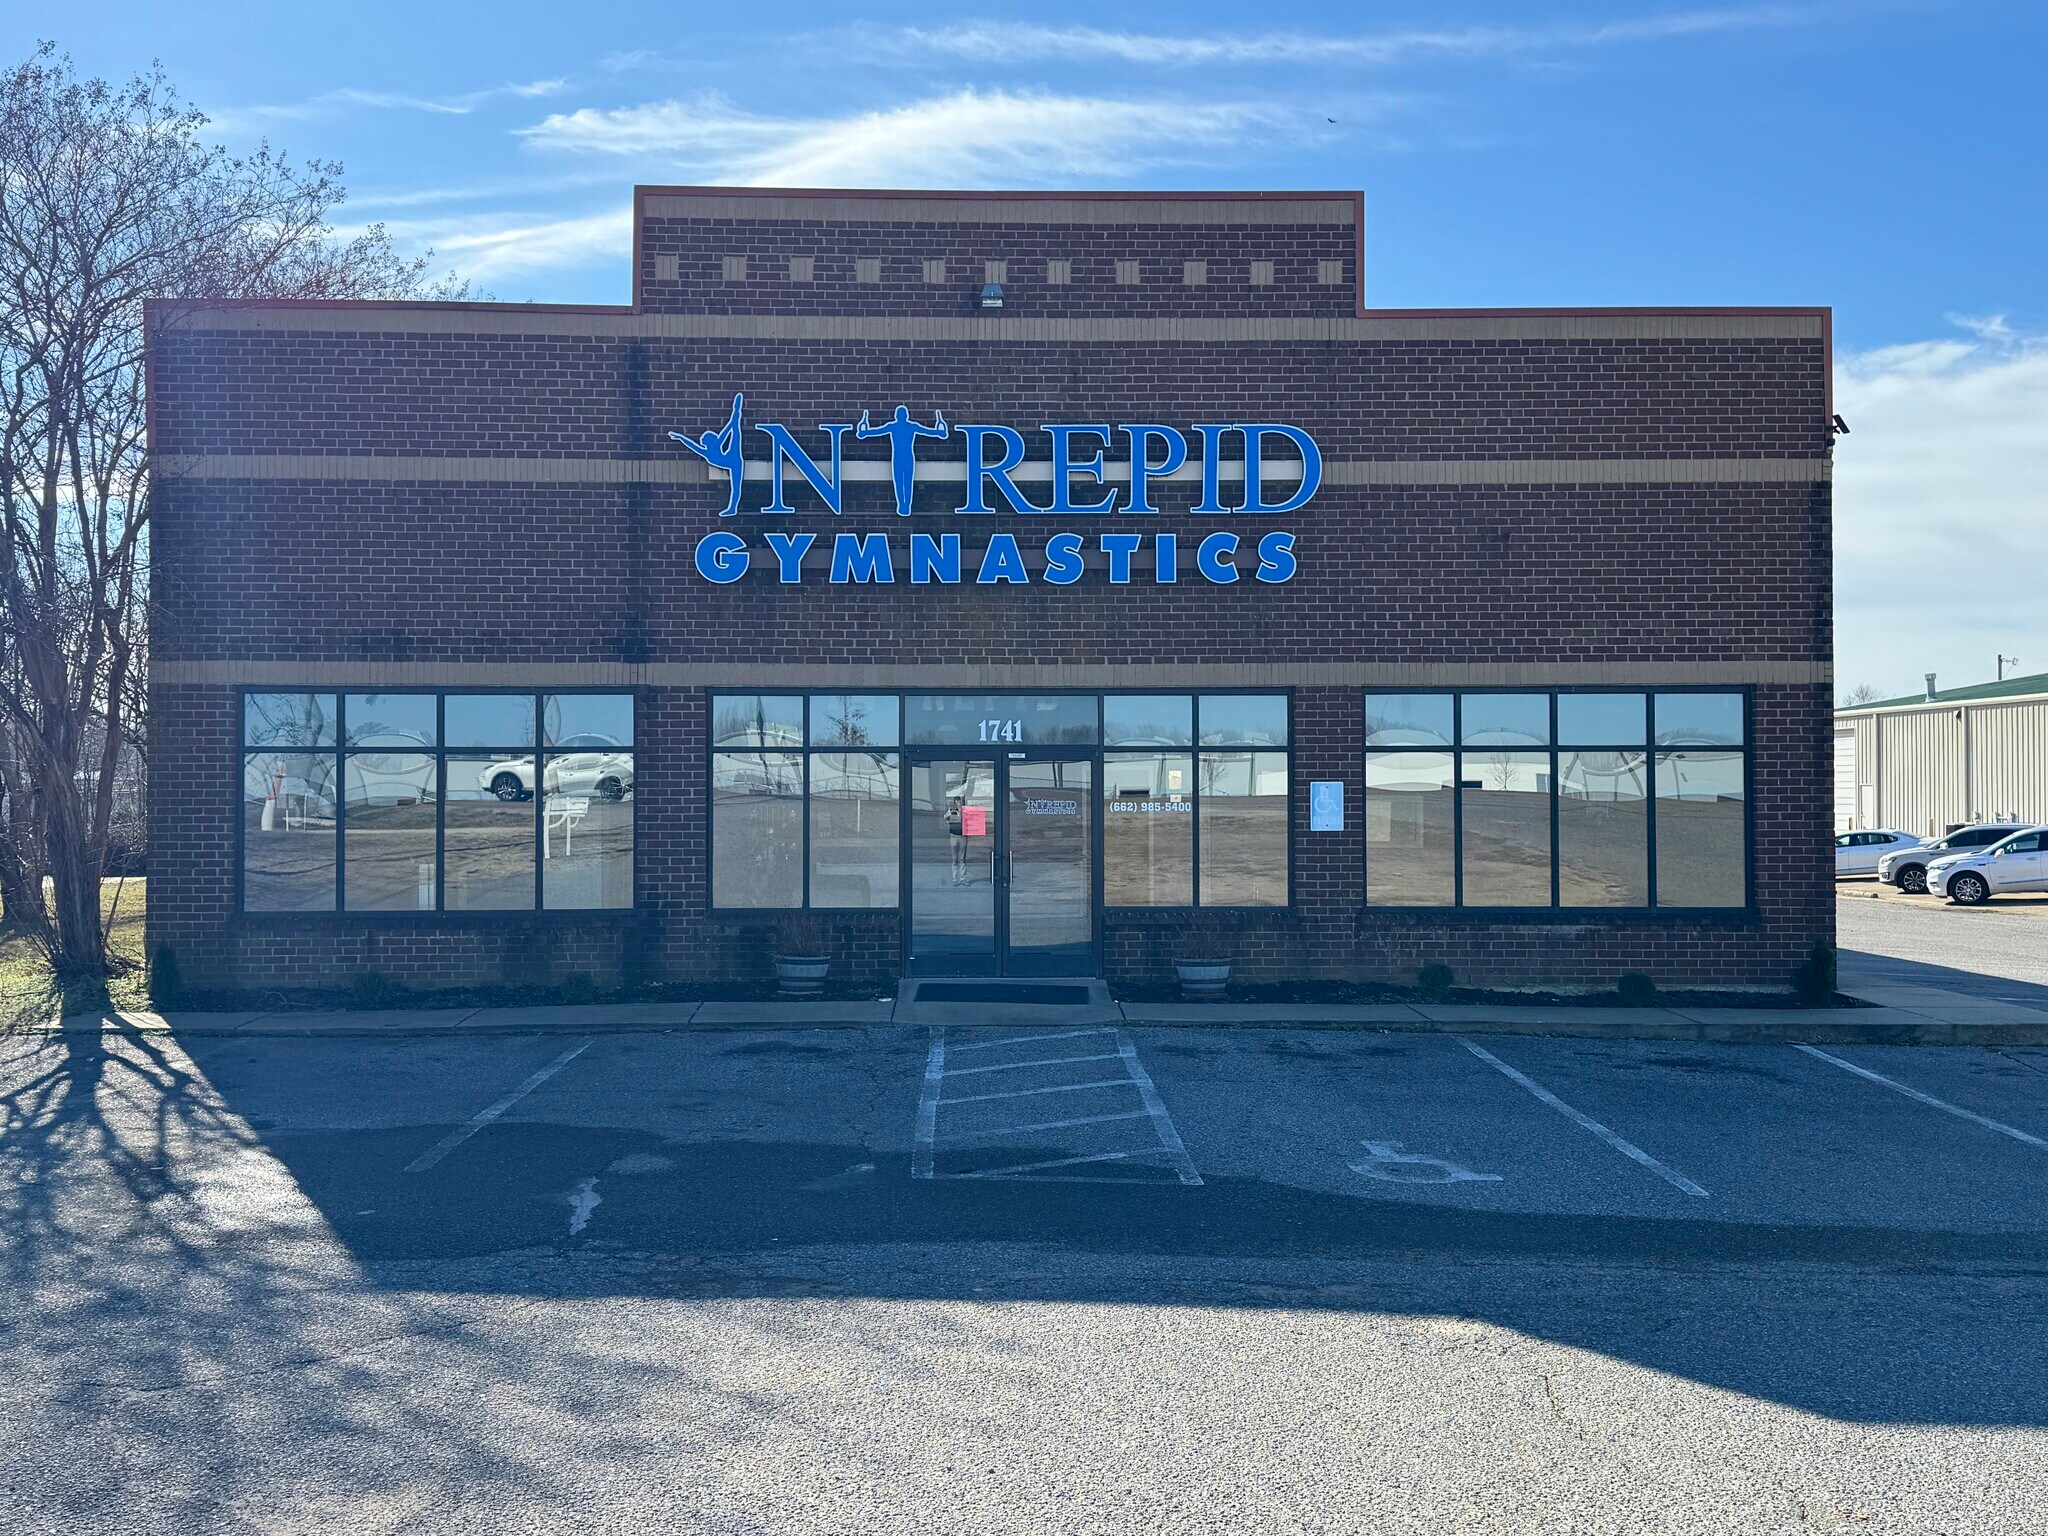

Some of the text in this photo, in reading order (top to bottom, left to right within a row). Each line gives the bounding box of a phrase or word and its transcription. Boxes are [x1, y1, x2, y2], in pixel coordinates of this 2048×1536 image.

[695, 531, 1298, 584] GYMNASTICS
[978, 719, 1023, 742] 1741
[1109, 801, 1191, 813] (662) 985-5400
